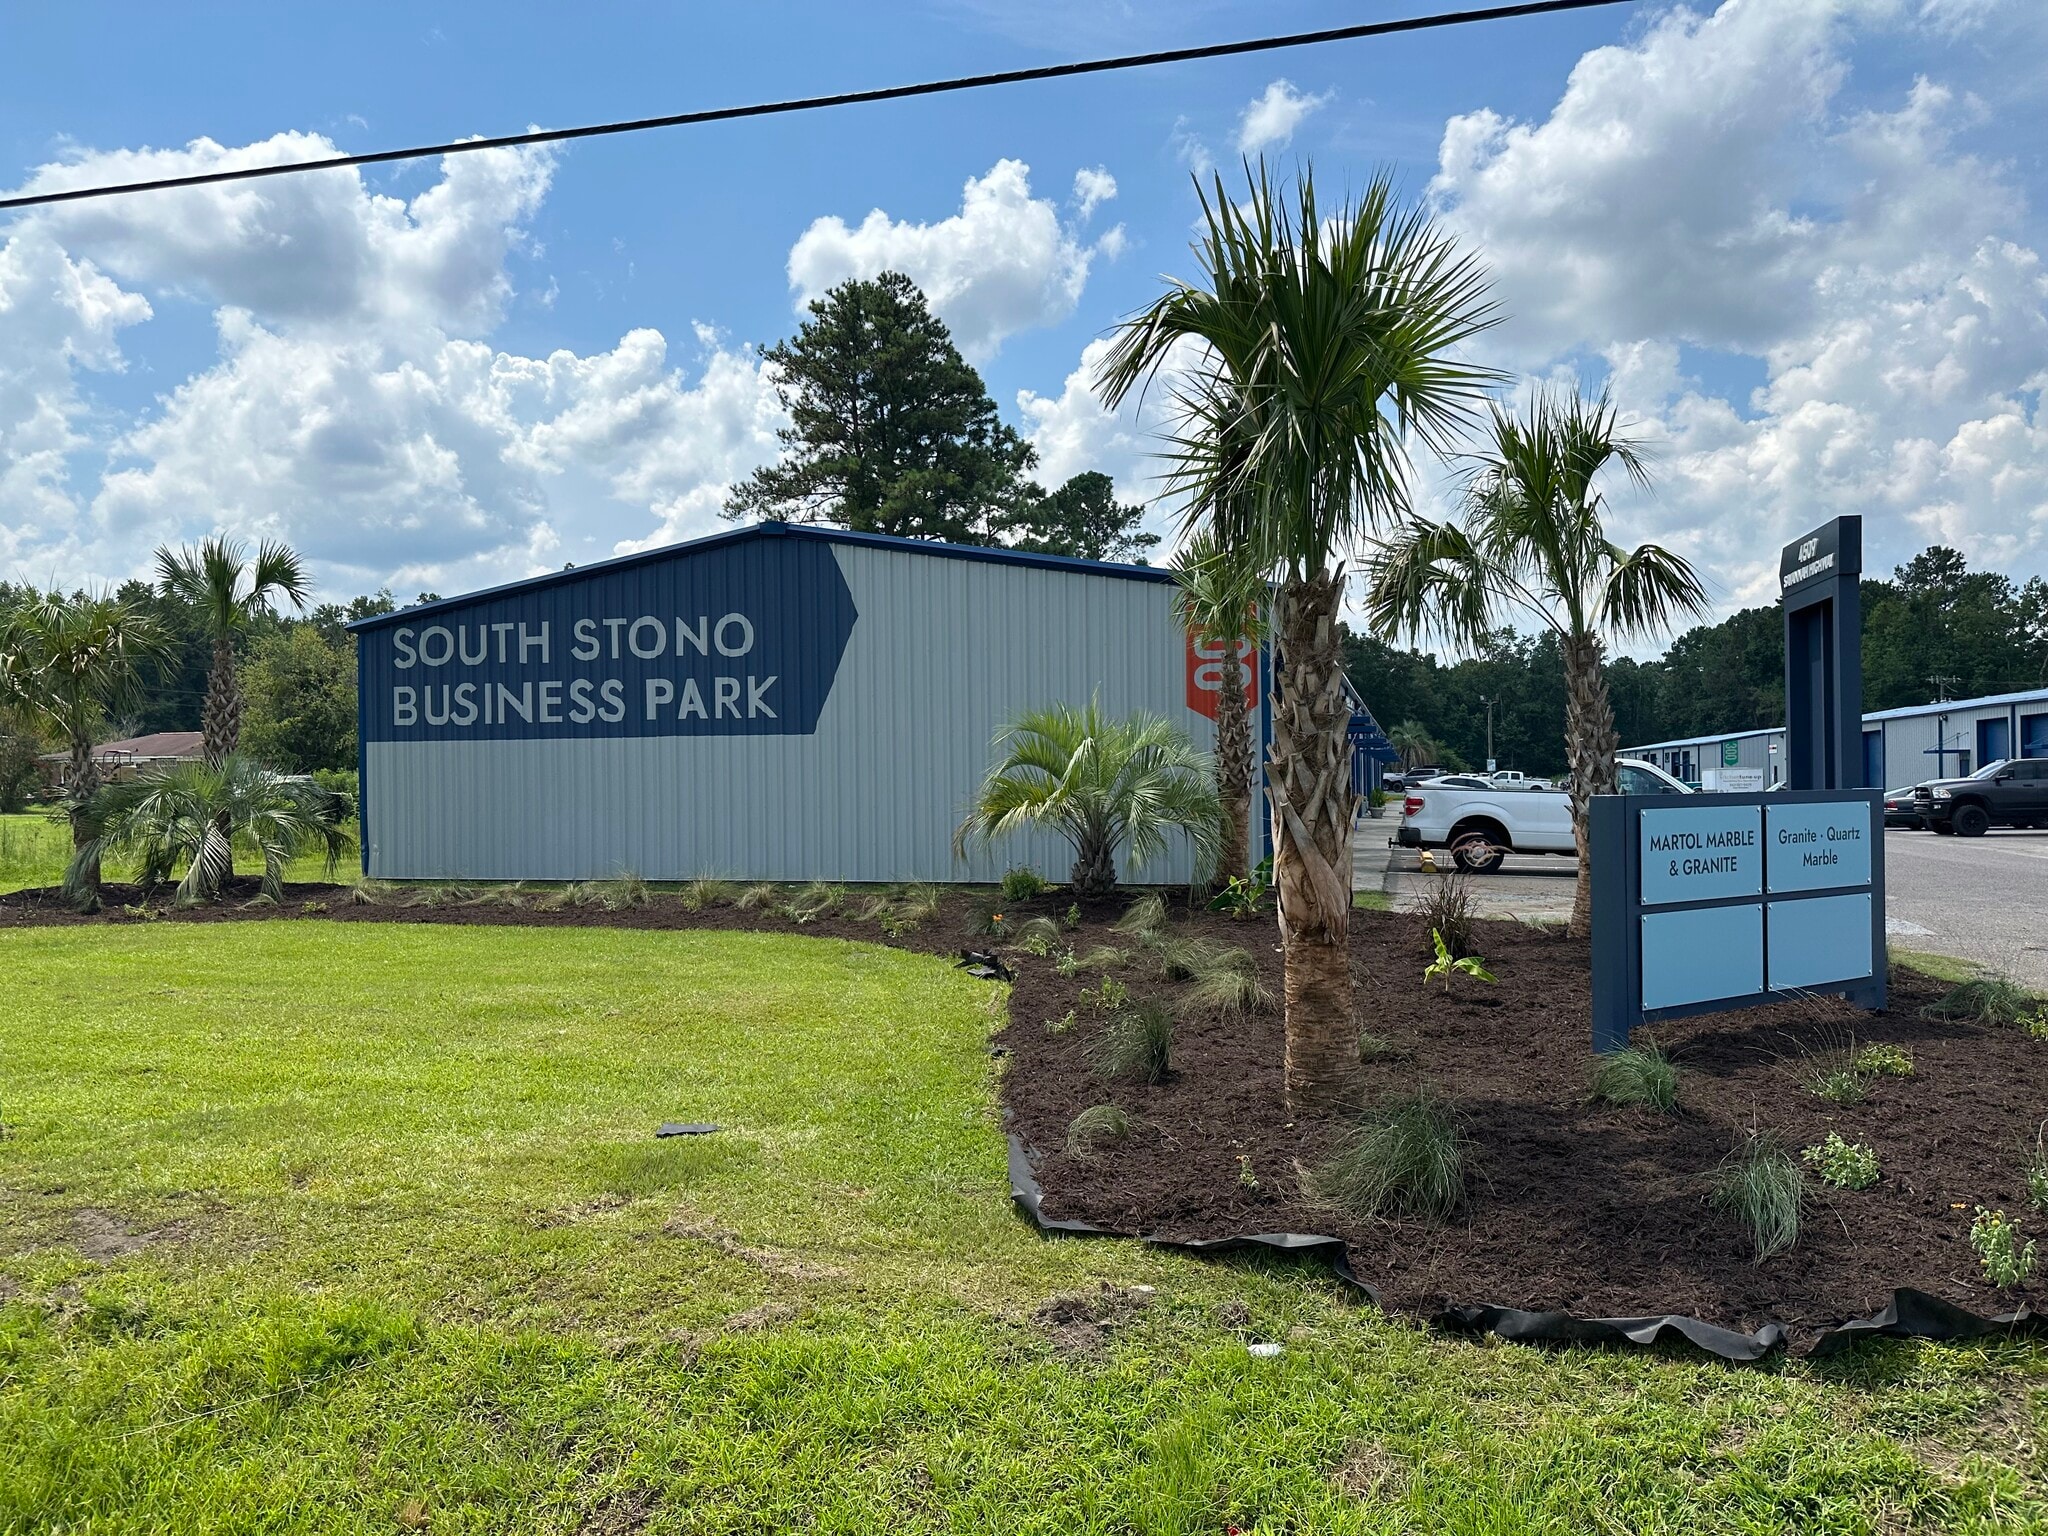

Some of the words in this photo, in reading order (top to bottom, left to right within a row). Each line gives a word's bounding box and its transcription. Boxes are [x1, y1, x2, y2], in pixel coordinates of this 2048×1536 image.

[394, 621, 550, 668] SOUTH
[571, 613, 754, 660] STONO
[393, 679, 626, 726] BUSINESS
[646, 676, 778, 720] PARK
[1725, 743, 1737, 760] 300
[1650, 833, 1702, 851] MARTOL
[1706, 830, 1754, 849] MARBLE
[1778, 828, 1817, 845] Granite
[1826, 827, 1860, 842] Quartz
[1669, 860, 1678, 876] &
[1682, 856, 1737, 876] GRANITE
[1802, 850, 1838, 868] Marble
